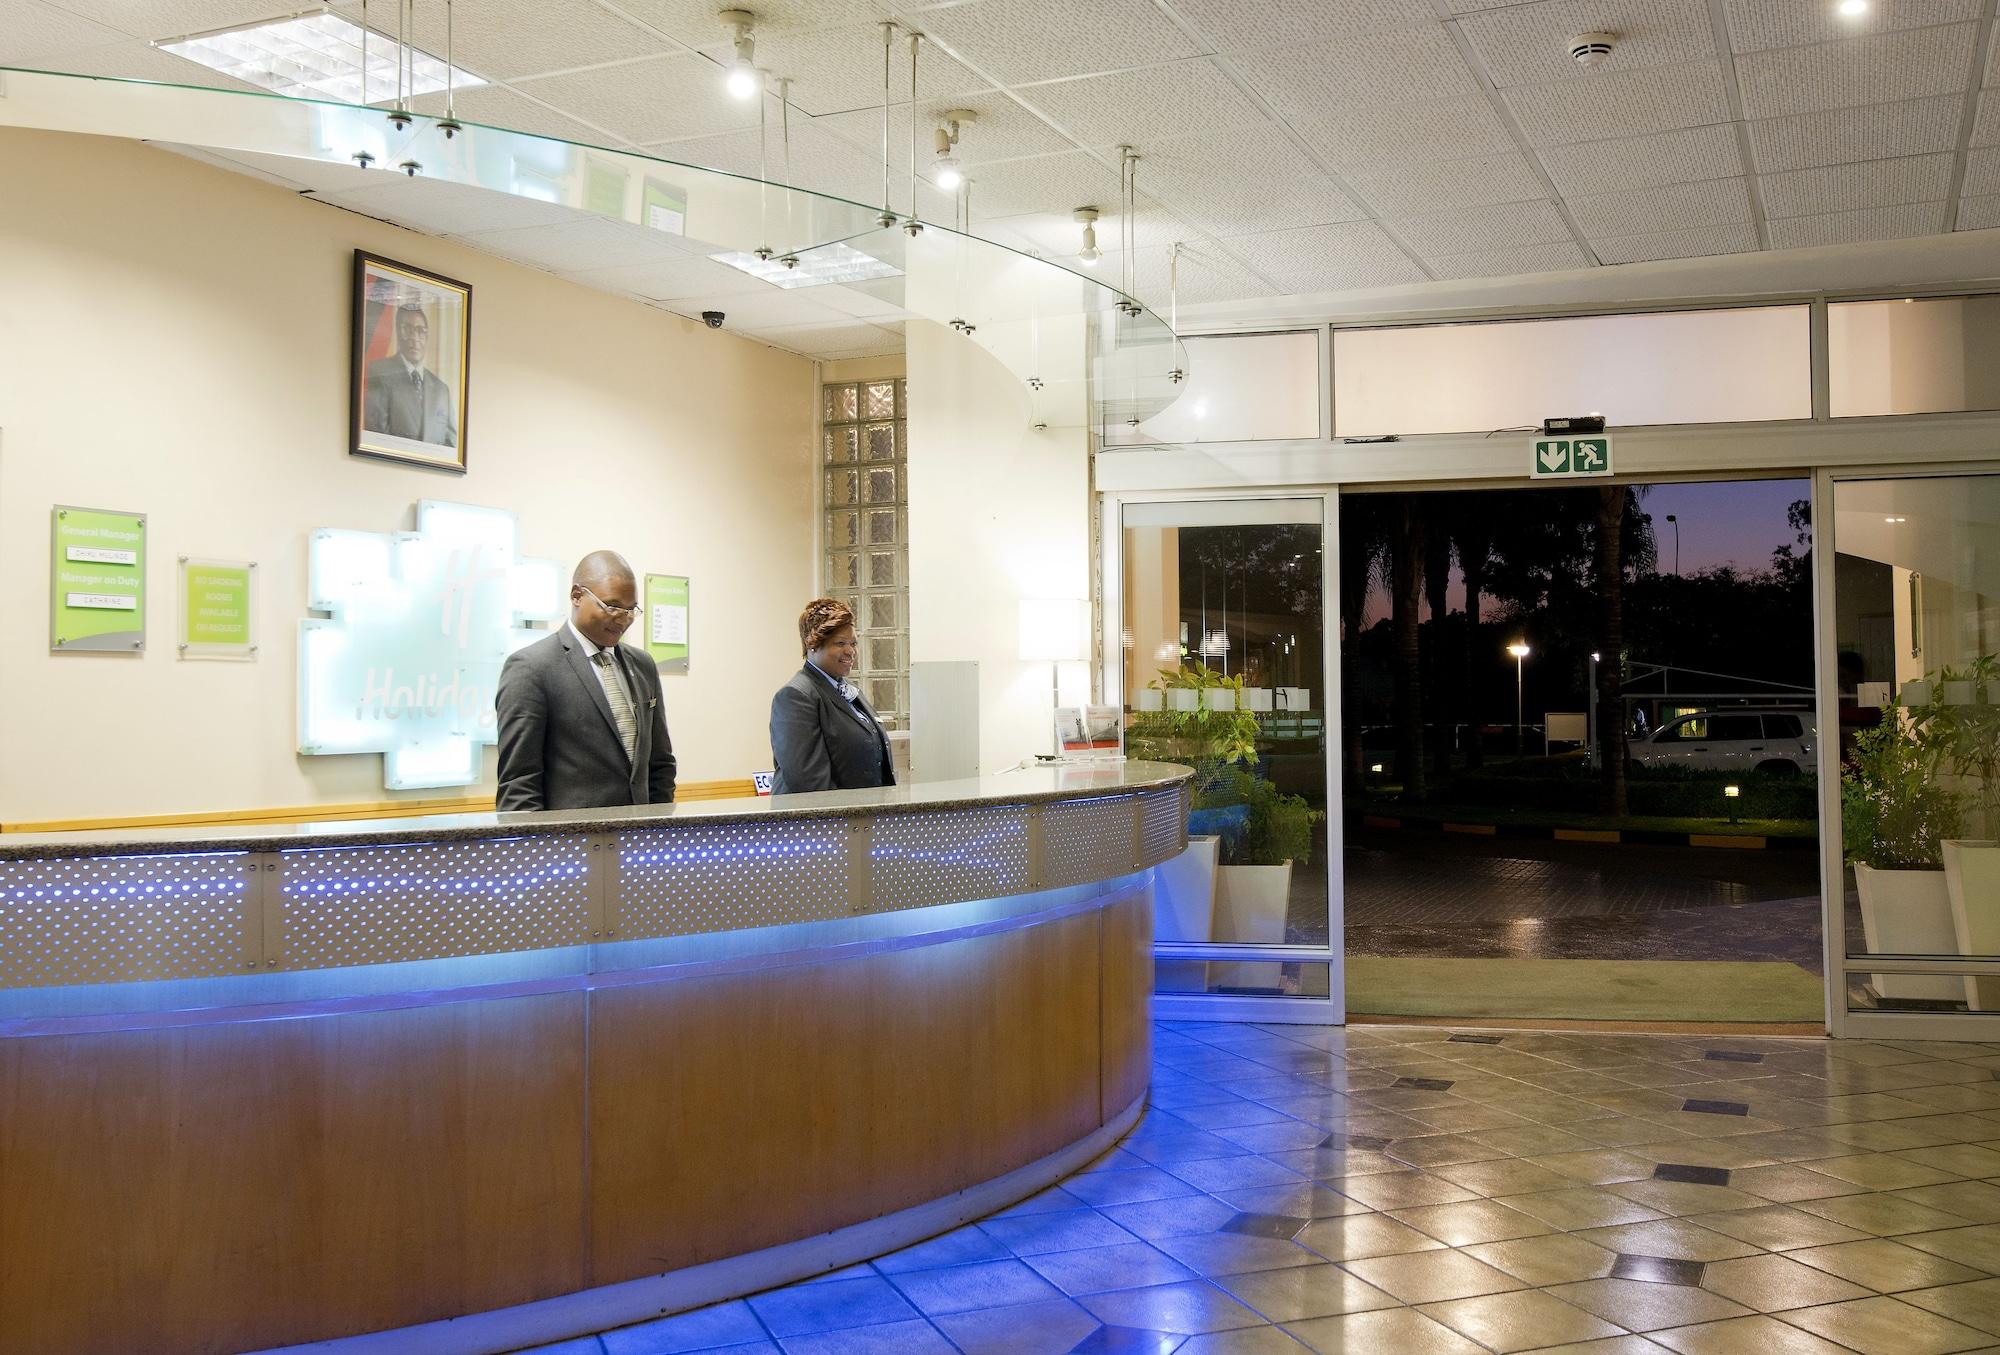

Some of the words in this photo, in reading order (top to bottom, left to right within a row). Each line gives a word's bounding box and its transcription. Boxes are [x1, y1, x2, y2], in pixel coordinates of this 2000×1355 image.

[61, 524, 98, 536] General
[99, 528, 139, 542] Manager
[61, 572, 103, 585] Manager
[103, 576, 116, 585] on
[117, 576, 139, 588] Duty
[199, 607, 240, 617] AVAILABLE
[208, 624, 241, 633] REQUEST
[355, 666, 497, 729] Holiday
